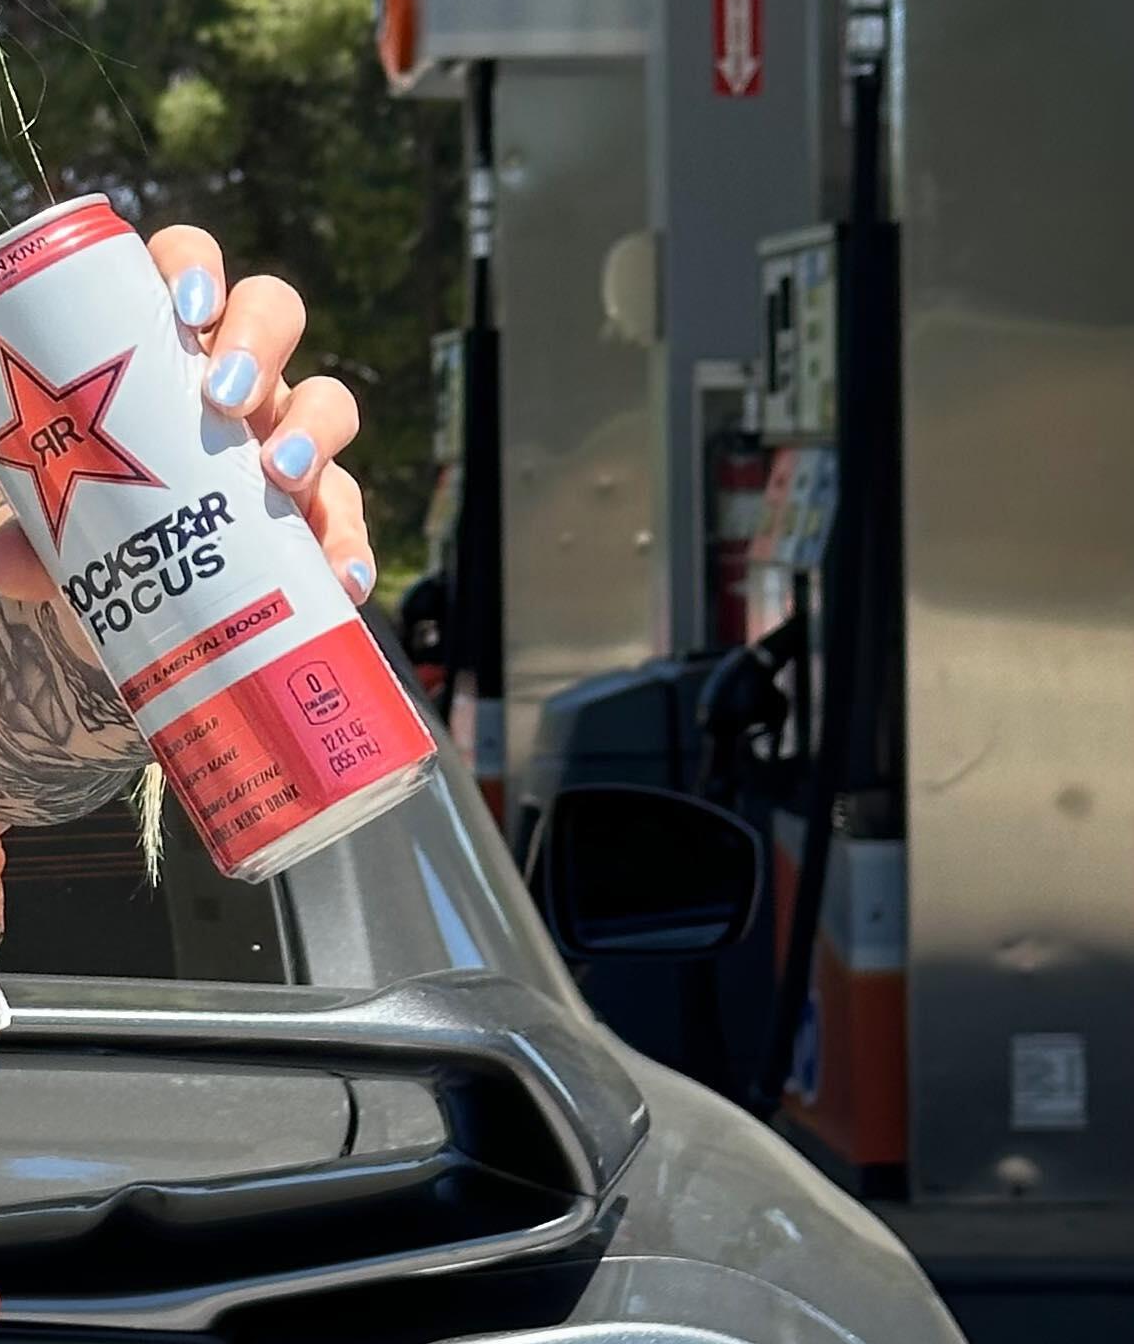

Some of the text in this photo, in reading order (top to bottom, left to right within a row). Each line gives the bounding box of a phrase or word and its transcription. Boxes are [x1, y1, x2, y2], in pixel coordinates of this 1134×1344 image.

[89, 543, 225, 646] FOCUS
[162, 636, 222, 678] MENTAL
[225, 601, 281, 640] BOOST
[306, 673, 322, 693] 0
[183, 716, 220, 745] SUGAR
[321, 733, 339, 754] 12
[334, 727, 353, 745] FL
[207, 745, 240, 774] MANE
[329, 747, 357, 778] (355
[226, 761, 282, 804] CAFFEINE
[265, 782, 302, 813] DRINK
